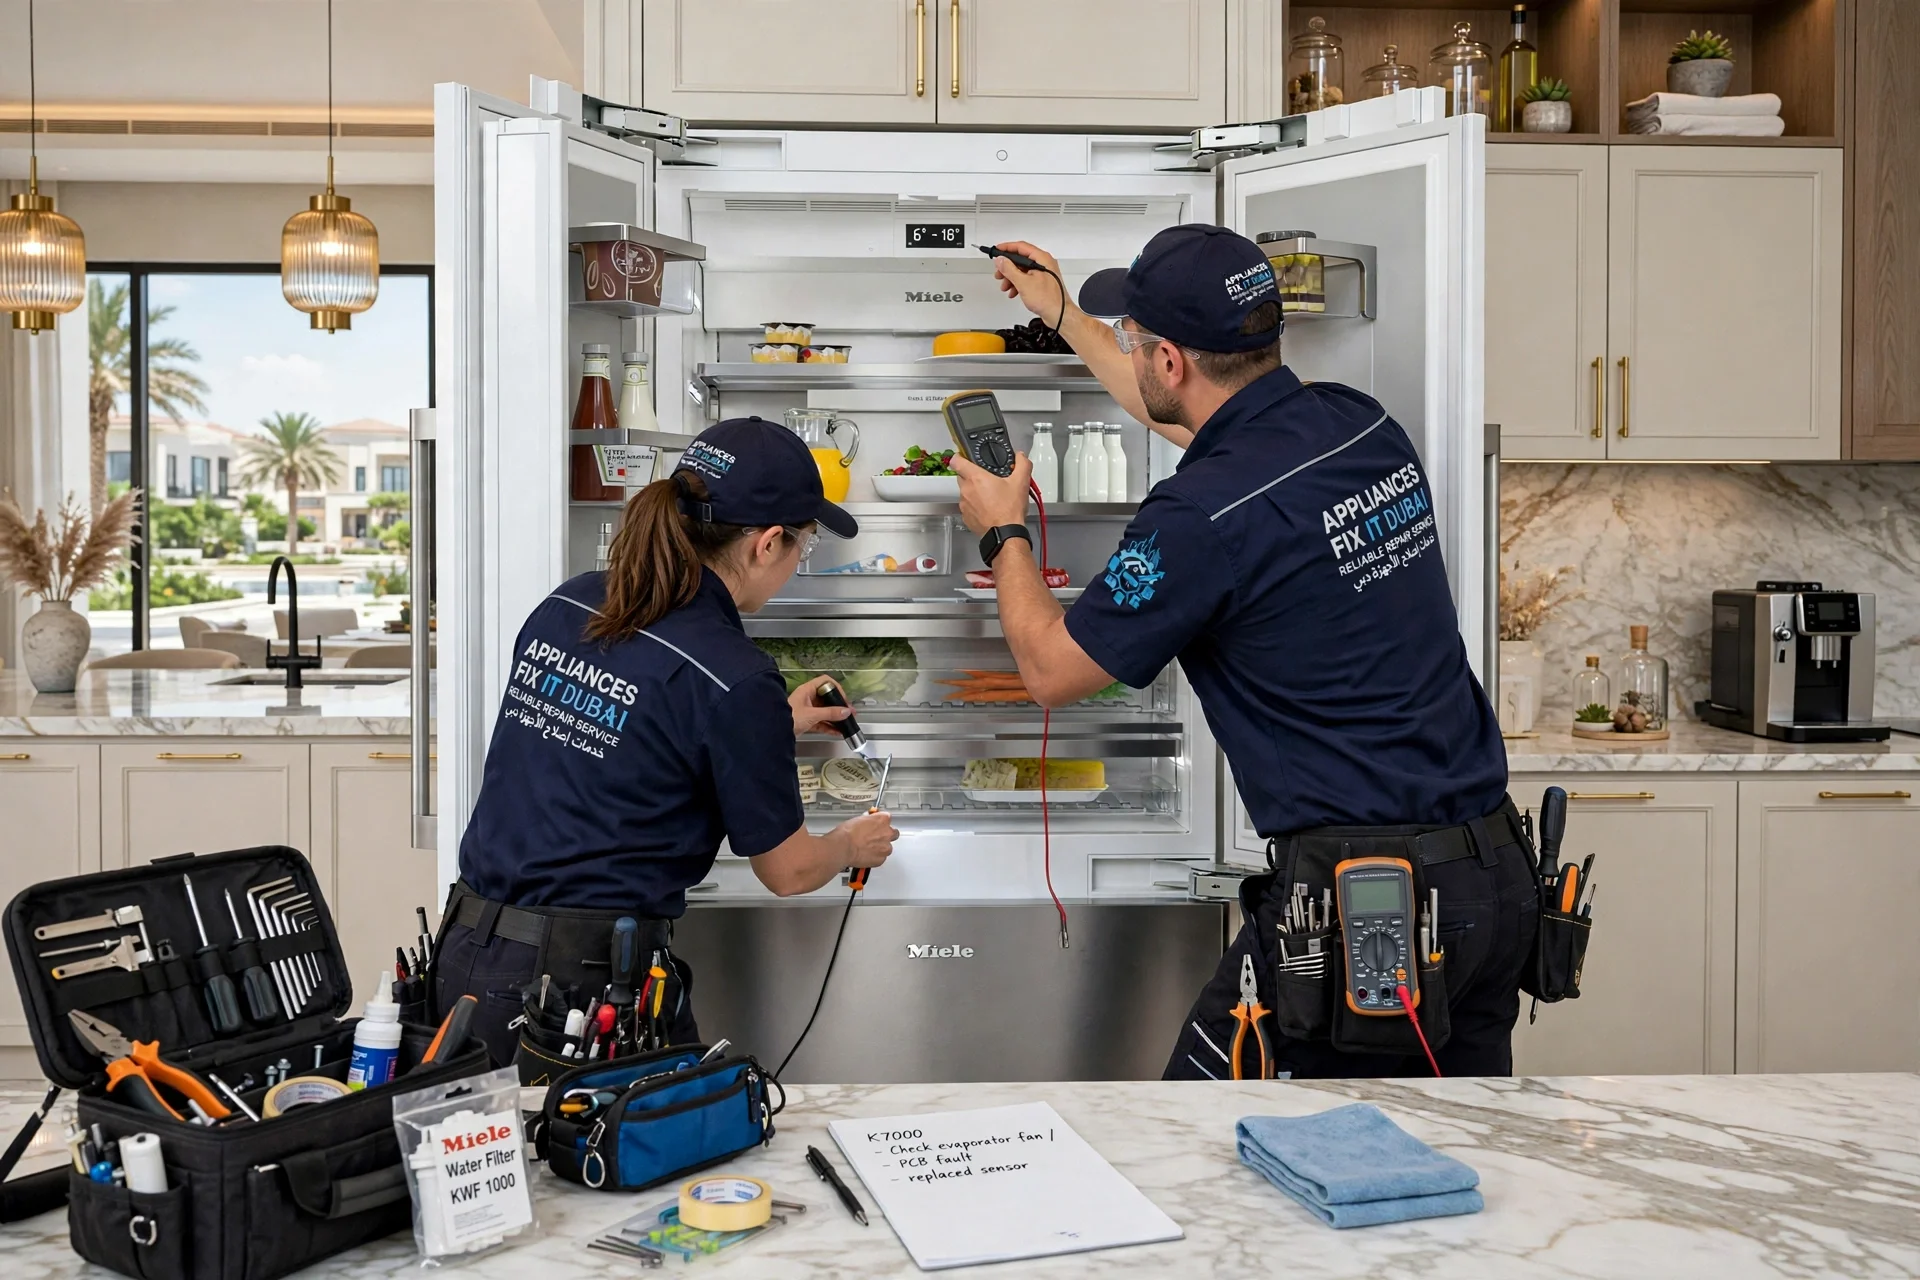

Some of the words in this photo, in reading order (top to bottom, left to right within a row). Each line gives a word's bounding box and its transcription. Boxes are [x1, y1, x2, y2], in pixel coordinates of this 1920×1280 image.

[913, 227, 926, 241] 6°
[905, 292, 964, 303] Miele
[1227, 284, 1243, 296] FIX
[1322, 462, 1420, 534] APPLIANCES
[1330, 525, 1367, 559] FIX
[1365, 515, 1383, 541] IT
[1383, 487, 1429, 531] DUBAI
[1338, 546, 1385, 576] RELIABLE
[524, 638, 639, 706] APPLIANCES
[514, 660, 543, 689] FIX
[540, 673, 563, 697] IT
[560, 683, 628, 732] DUBAI
[508, 685, 543, 711] RELIABLE
[542, 703, 575, 726] REPAIR
[575, 720, 620, 748] SERVICE
[906, 944, 974, 958] Miele
[441, 1125, 511, 1155] Miele
[867, 1129, 923, 1143] K7000
[890, 1142, 932, 1155] Check
[938, 1135, 1011, 1151] evaporator
[1017, 1131, 1043, 1142] fan
[445, 1158, 483, 1178] Water
[485, 1149, 516, 1168] Filter
[899, 1157, 928, 1169] PCB
[936, 1152, 973, 1165] fault
[908, 1167, 973, 1184] replaced
[980, 1161, 1029, 1175] sensor
[450, 1182, 481, 1205] KWF
[485, 1172, 516, 1195] 1000
